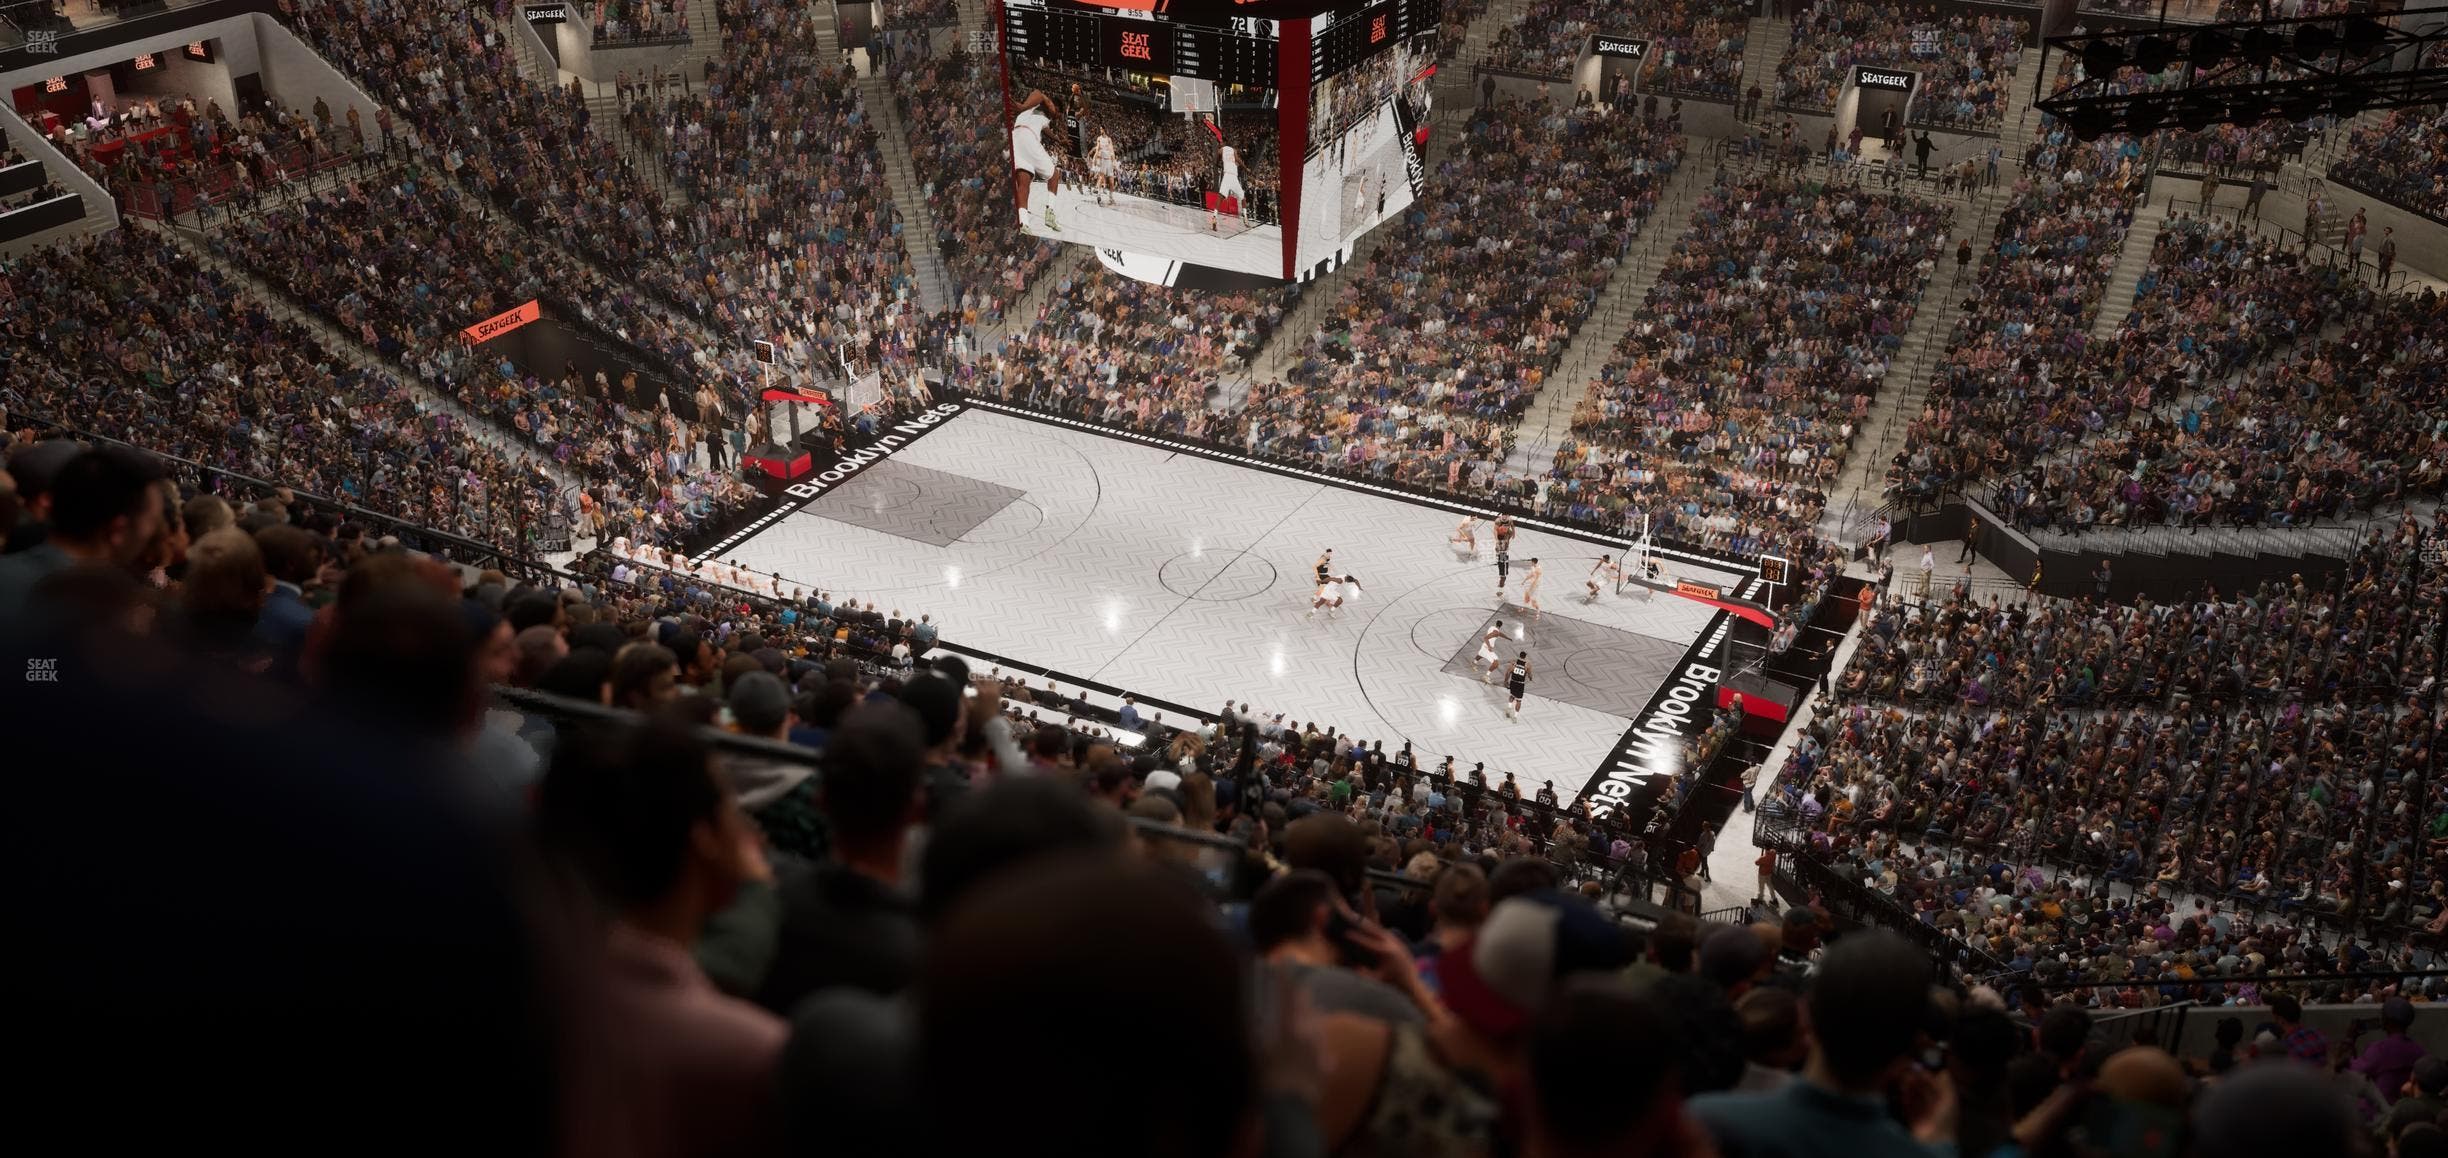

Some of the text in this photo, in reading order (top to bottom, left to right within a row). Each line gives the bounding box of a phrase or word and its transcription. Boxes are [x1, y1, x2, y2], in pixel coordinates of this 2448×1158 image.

[526, 8, 566, 20] SEATGEEK
[1231, 16, 1246, 30] 72
[1372, 14, 1386, 30] SEAT
[1122, 32, 1149, 46] SEAT
[1121, 45, 1151, 60] GEEK
[1599, 40, 1640, 56] SEATGEEK
[135, 59, 155, 70] GEEK
[46, 81, 68, 93] GEEK
[1861, 71, 1908, 88] SEATGEEK
[478, 310, 524, 338] SEATGEEK
[784, 403, 961, 498] Brooklyn Nets
[1590, 663, 1721, 819] Brooklyn Nets
[1539, 795, 1551, 806] 00
